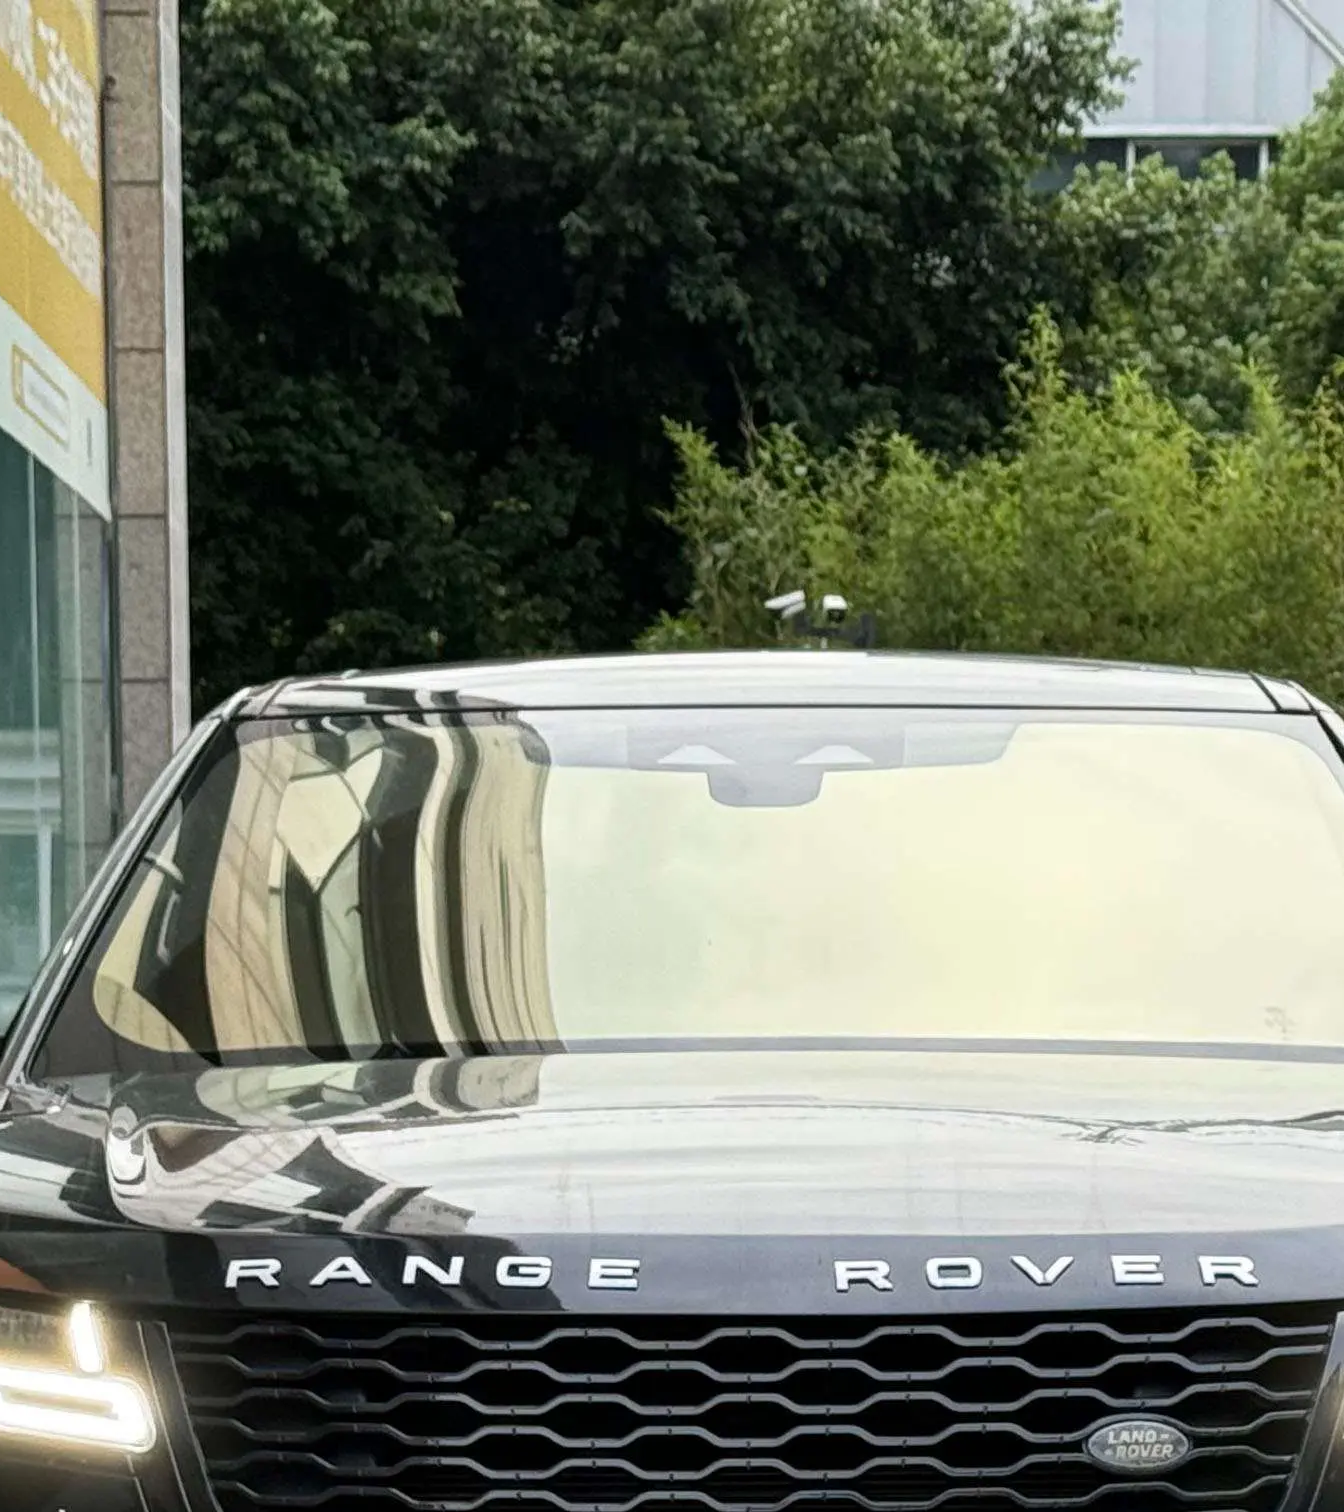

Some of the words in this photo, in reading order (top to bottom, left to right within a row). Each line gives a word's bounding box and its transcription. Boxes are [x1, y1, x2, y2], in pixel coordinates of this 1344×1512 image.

[224, 1256, 642, 1289] RANGE
[833, 1254, 1260, 1291] ROVER
[1107, 1430, 1158, 1445] LAND
[1115, 1443, 1175, 1459] ROVER
